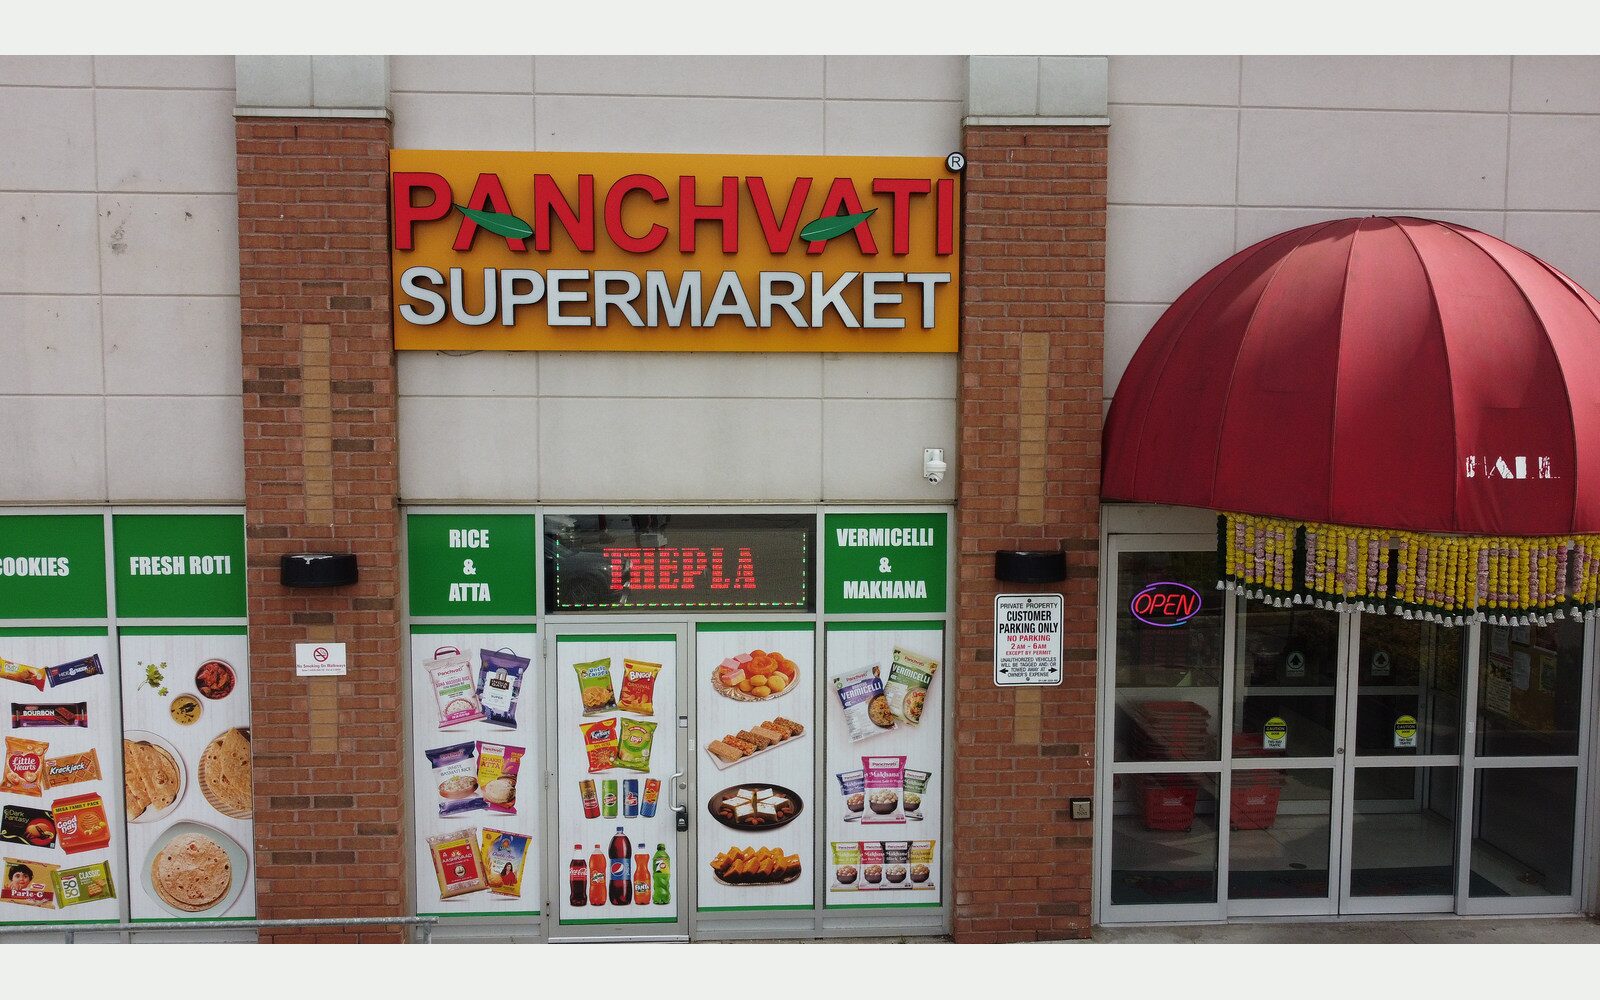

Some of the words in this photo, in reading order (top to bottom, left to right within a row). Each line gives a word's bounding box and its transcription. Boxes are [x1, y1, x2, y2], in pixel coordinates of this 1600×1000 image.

[393, 172, 954, 255] PANCHVATI
[399, 266, 951, 329] SUPERMARKET
[449, 529, 490, 548] RICE
[836, 528, 934, 547] VERMICELLI
[0, 557, 70, 576] OOKIES
[130, 556, 185, 576] FRESH
[190, 556, 231, 574] ROTI
[462, 559, 476, 574] &
[878, 558, 892, 573] &
[448, 582, 491, 602] ATTA
[843, 580, 927, 600] MAKHANA
[1135, 594, 1196, 616] OPEN
[1006, 611, 1051, 621] CUSTOMER
[1000, 623, 1035, 633] PARKING
[1038, 623, 1058, 633] ONLY
[630, 671, 652, 681] BINGO!
[892, 664, 930, 684] VERMICELLI
[841, 682, 881, 700] VERMICELLI
[50, 762, 85, 775] Krackjack
[10, 809, 24, 818] Dark
[69, 803, 86, 811] FAMILY
[4, 815, 30, 823] Fantasy
[57, 815, 77, 829] Good
[79, 869, 100, 879] CLASSIC
[63, 880, 77, 890] 50
[64, 889, 78, 898] 50
